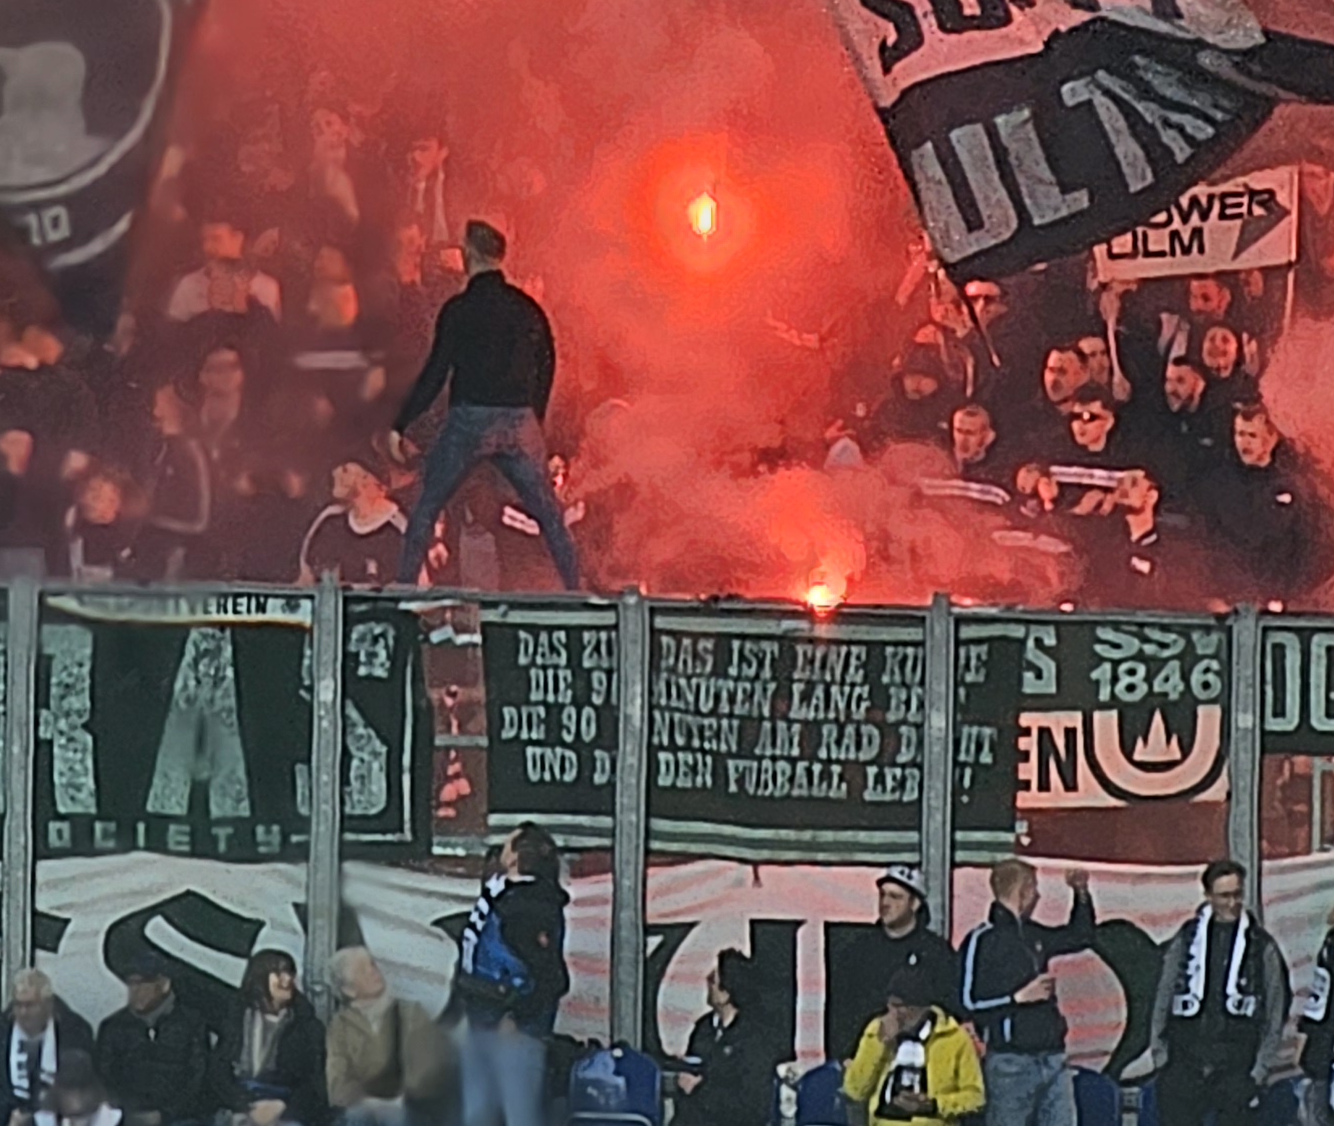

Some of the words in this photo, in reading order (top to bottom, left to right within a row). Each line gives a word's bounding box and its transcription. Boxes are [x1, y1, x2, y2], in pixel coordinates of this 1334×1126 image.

[518, 630, 566, 666] DAS
[660, 635, 715, 674] DAS
[728, 640, 779, 679] IST
[793, 644, 867, 682] EINE
[1090, 659, 1222, 703] 1846
[529, 668, 572, 704] DIE
[788, 682, 870, 722] LANG
[501, 706, 546, 741] DIE
[561, 706, 596, 743] 90
[652, 708, 740, 754] NUTEN
[754, 720, 801, 757] AM
[817, 724, 882, 762] RAD
[525, 746, 578, 783] UND
[657, 750, 713, 789] DEN
